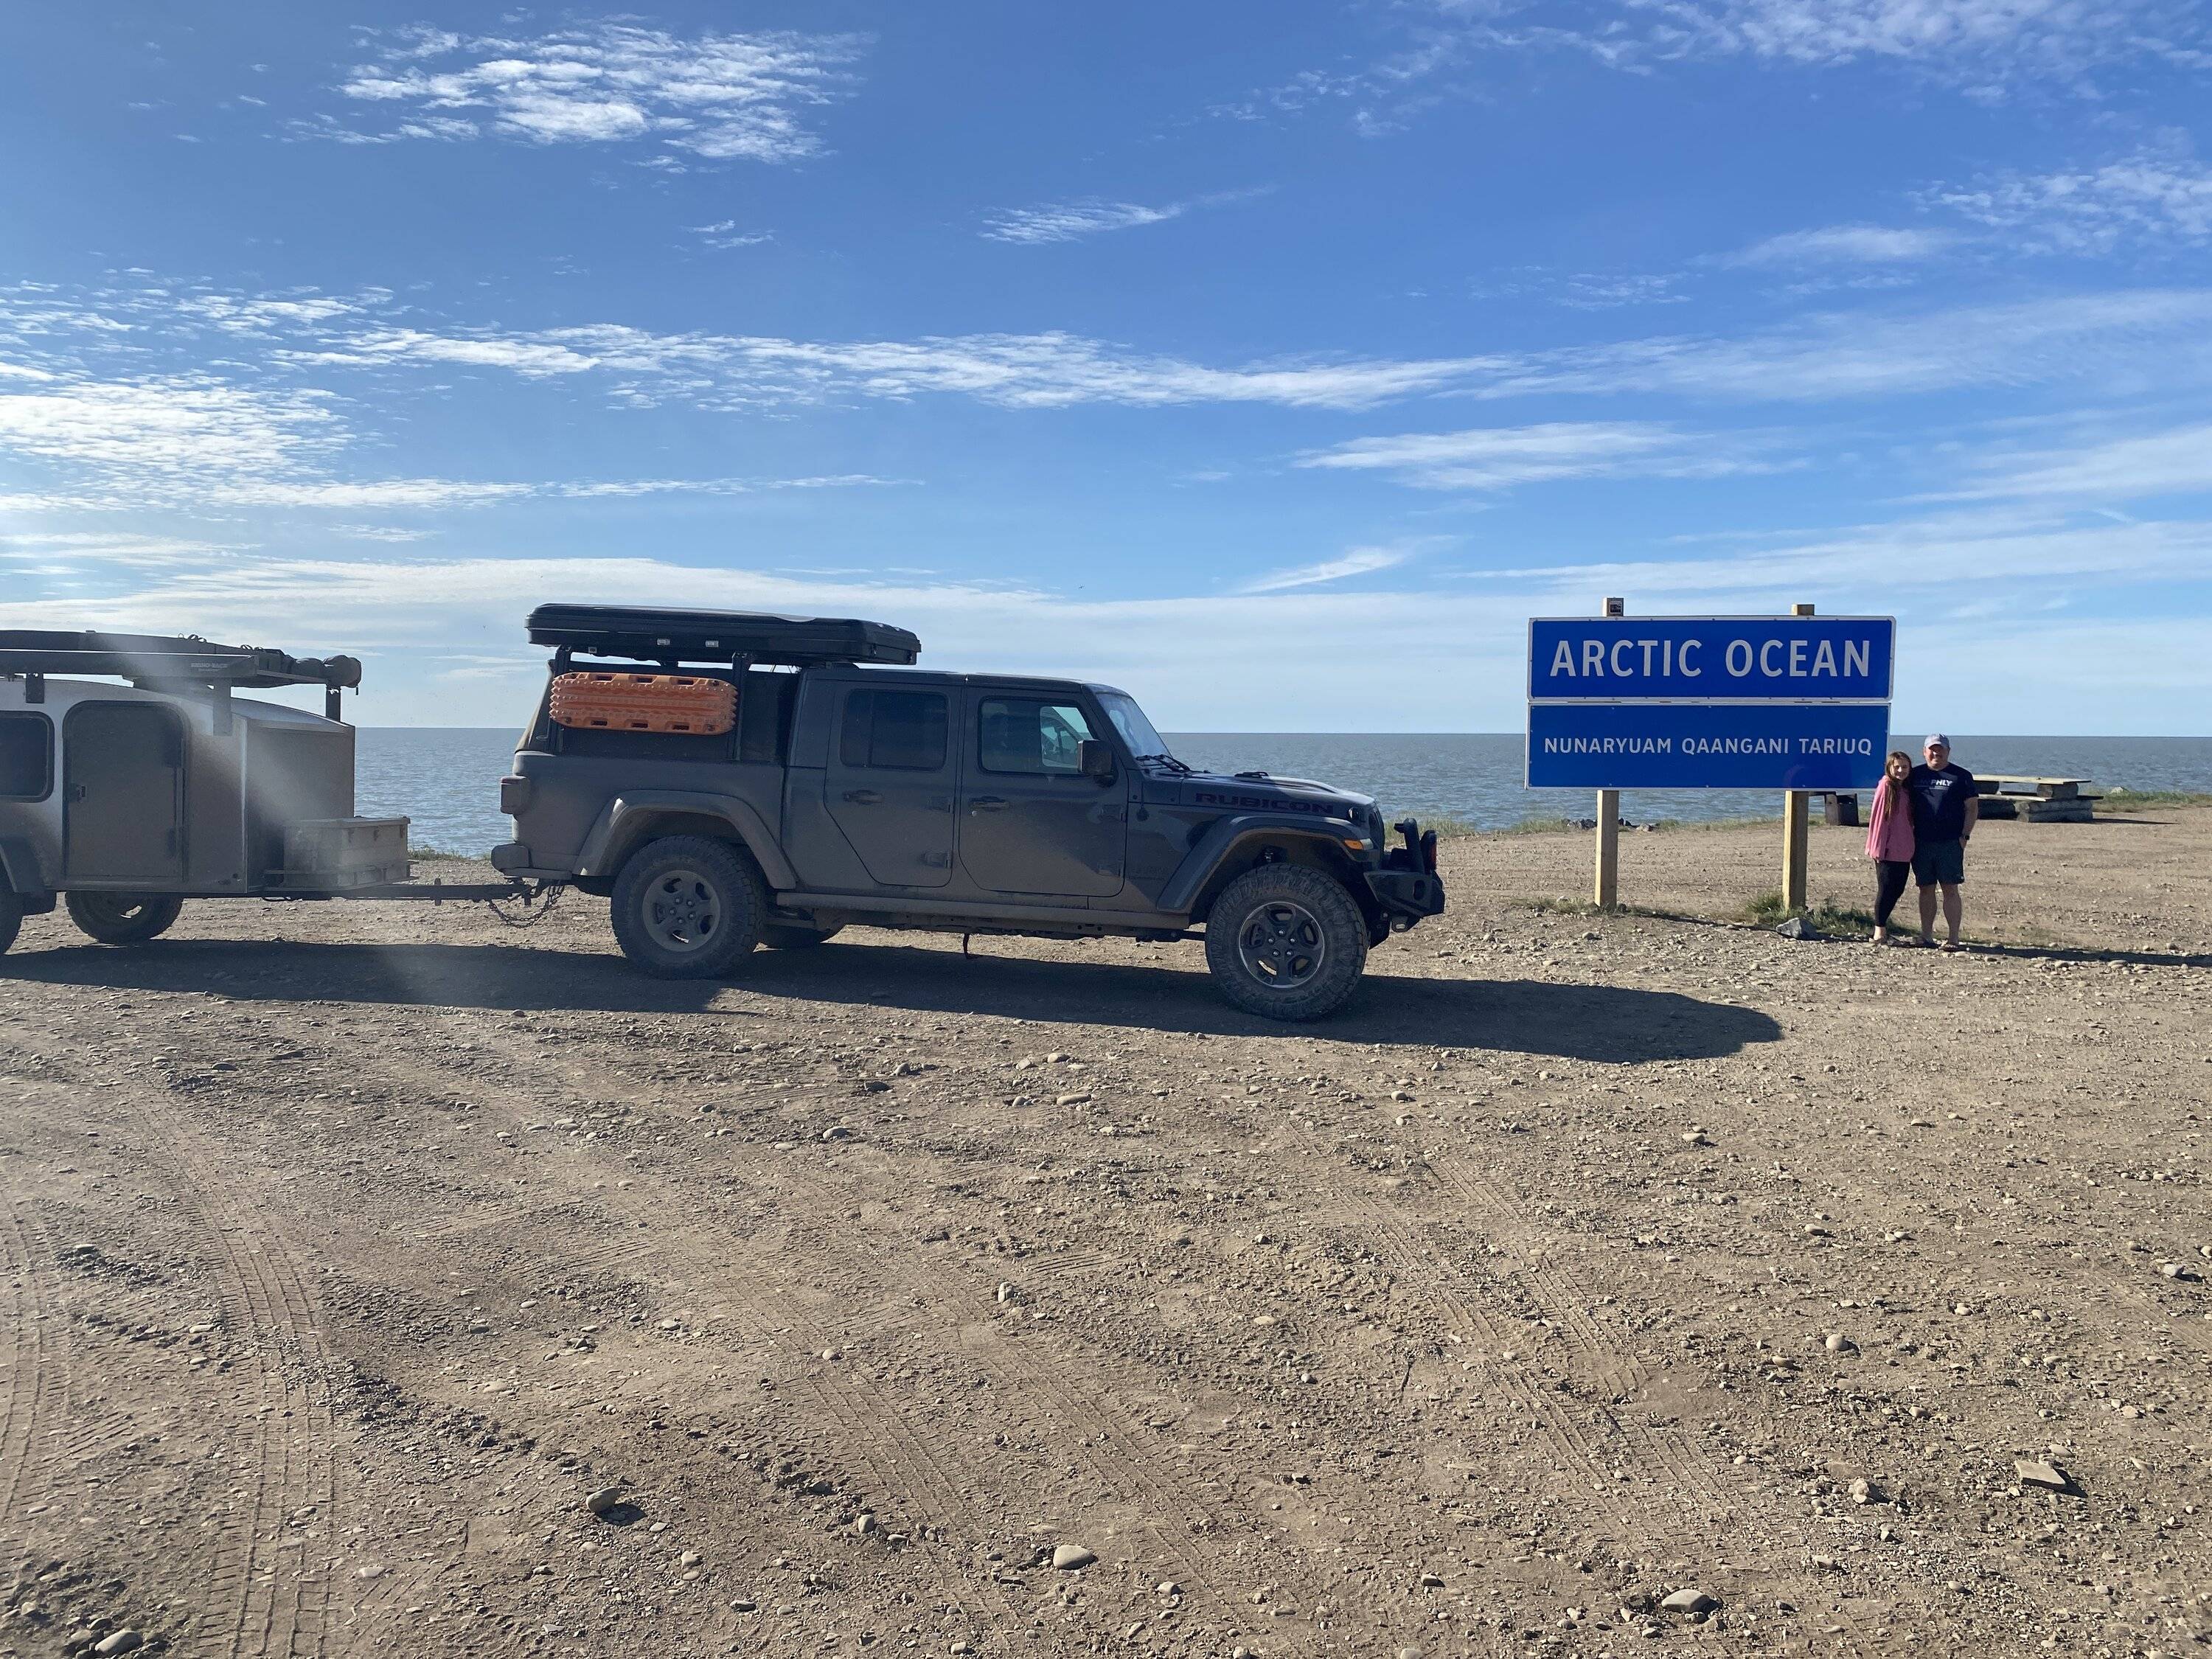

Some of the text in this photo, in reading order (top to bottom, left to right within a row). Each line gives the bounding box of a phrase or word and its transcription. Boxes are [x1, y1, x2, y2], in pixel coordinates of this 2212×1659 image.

[1550, 639, 1870, 677] ARCTIC OCEAN
[1545, 737, 1871, 756] NUNARYUAM QAANGANI TARIUQ
[1194, 793, 1334, 814] RUBICON
